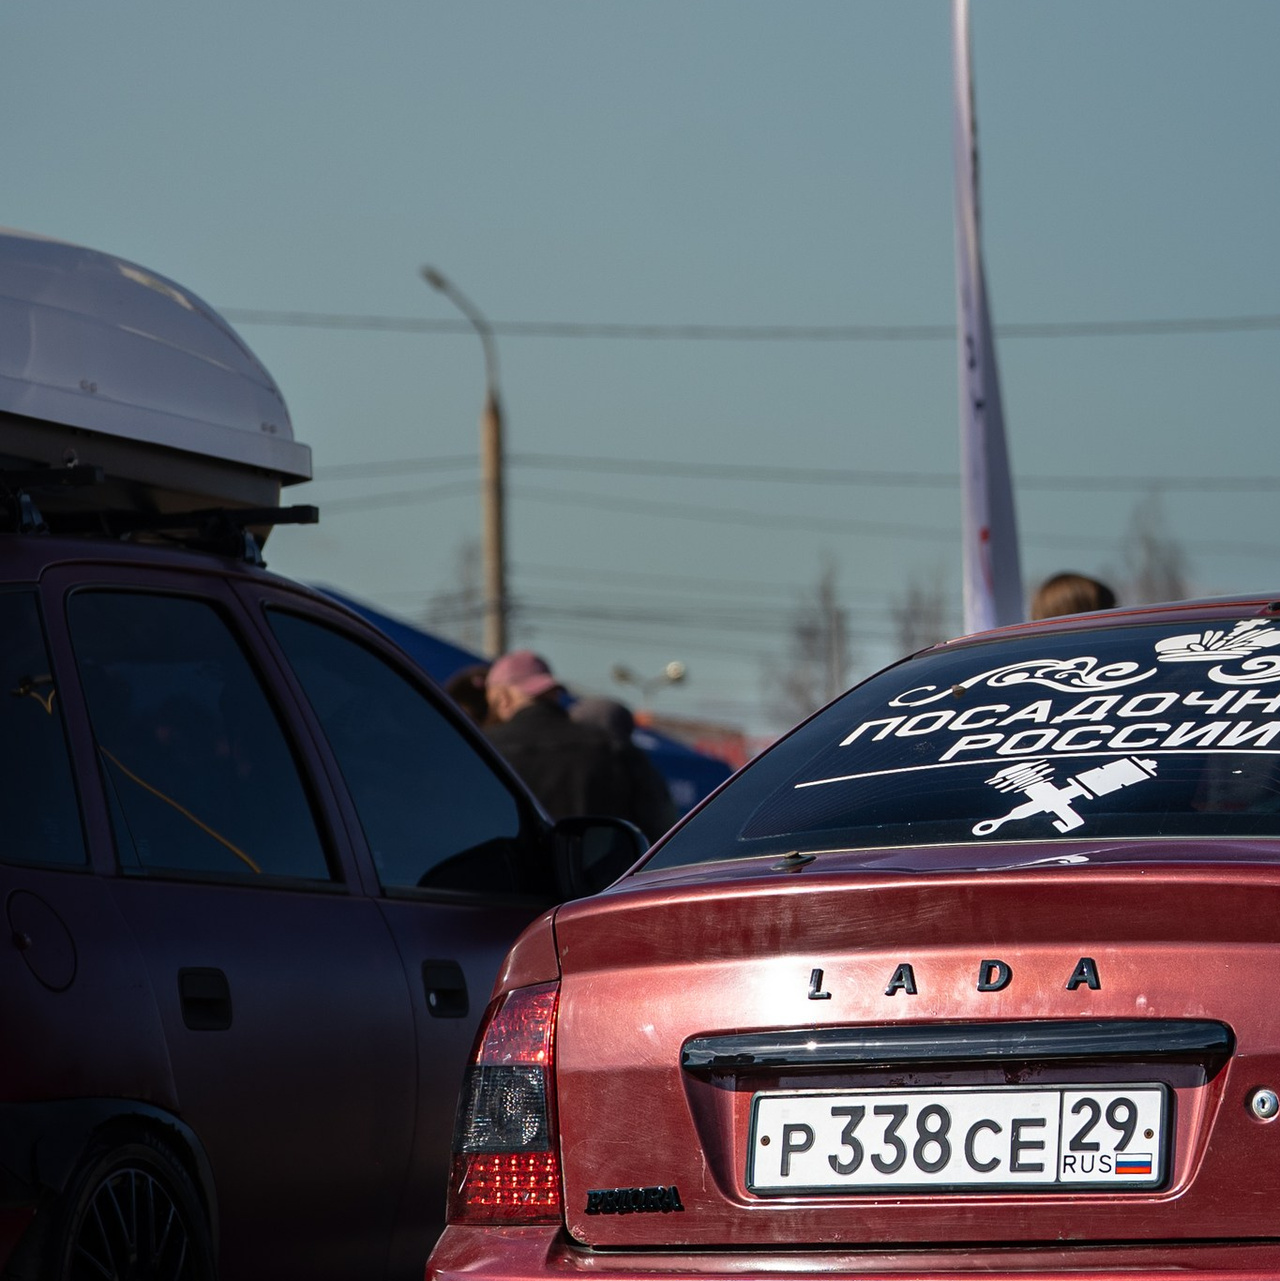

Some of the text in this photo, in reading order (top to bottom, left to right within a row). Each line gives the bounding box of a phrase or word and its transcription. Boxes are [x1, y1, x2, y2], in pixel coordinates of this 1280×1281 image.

[807, 957, 1102, 1000] LADA
[1069, 1096, 1136, 1152] 29
[1062, 1154, 1112, 1175] RUS
